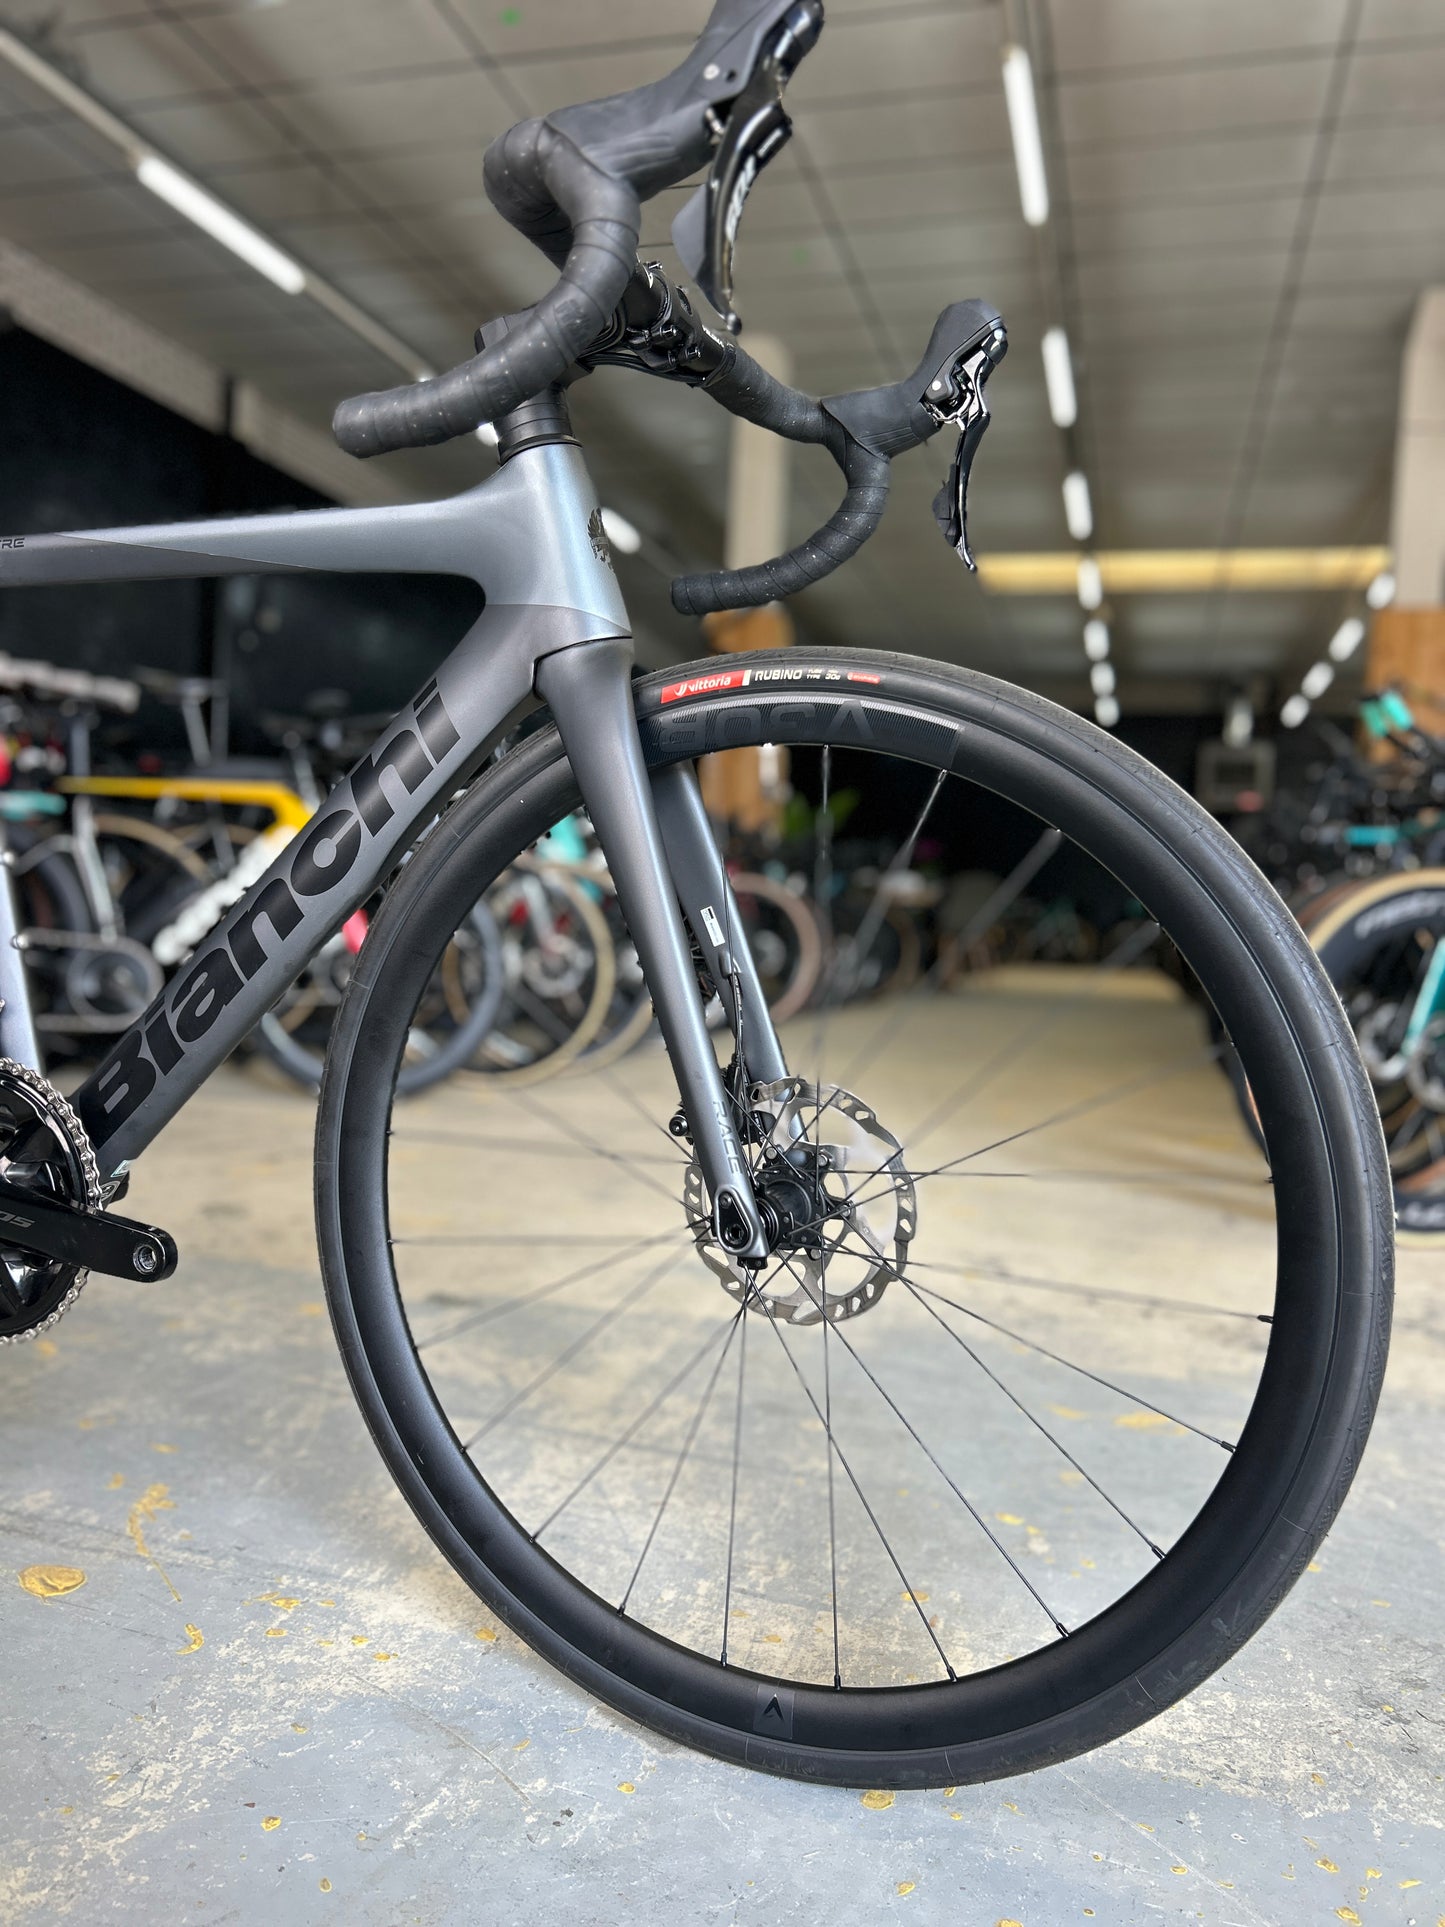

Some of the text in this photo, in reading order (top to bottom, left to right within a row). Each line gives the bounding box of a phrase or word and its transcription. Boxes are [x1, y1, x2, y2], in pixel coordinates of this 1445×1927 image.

[0, 537, 25, 549] RE
[688, 669, 803, 692] vittoria RUBINO
[79, 678, 461, 1148] Bianchi
[713, 1101, 743, 1174] RACE
